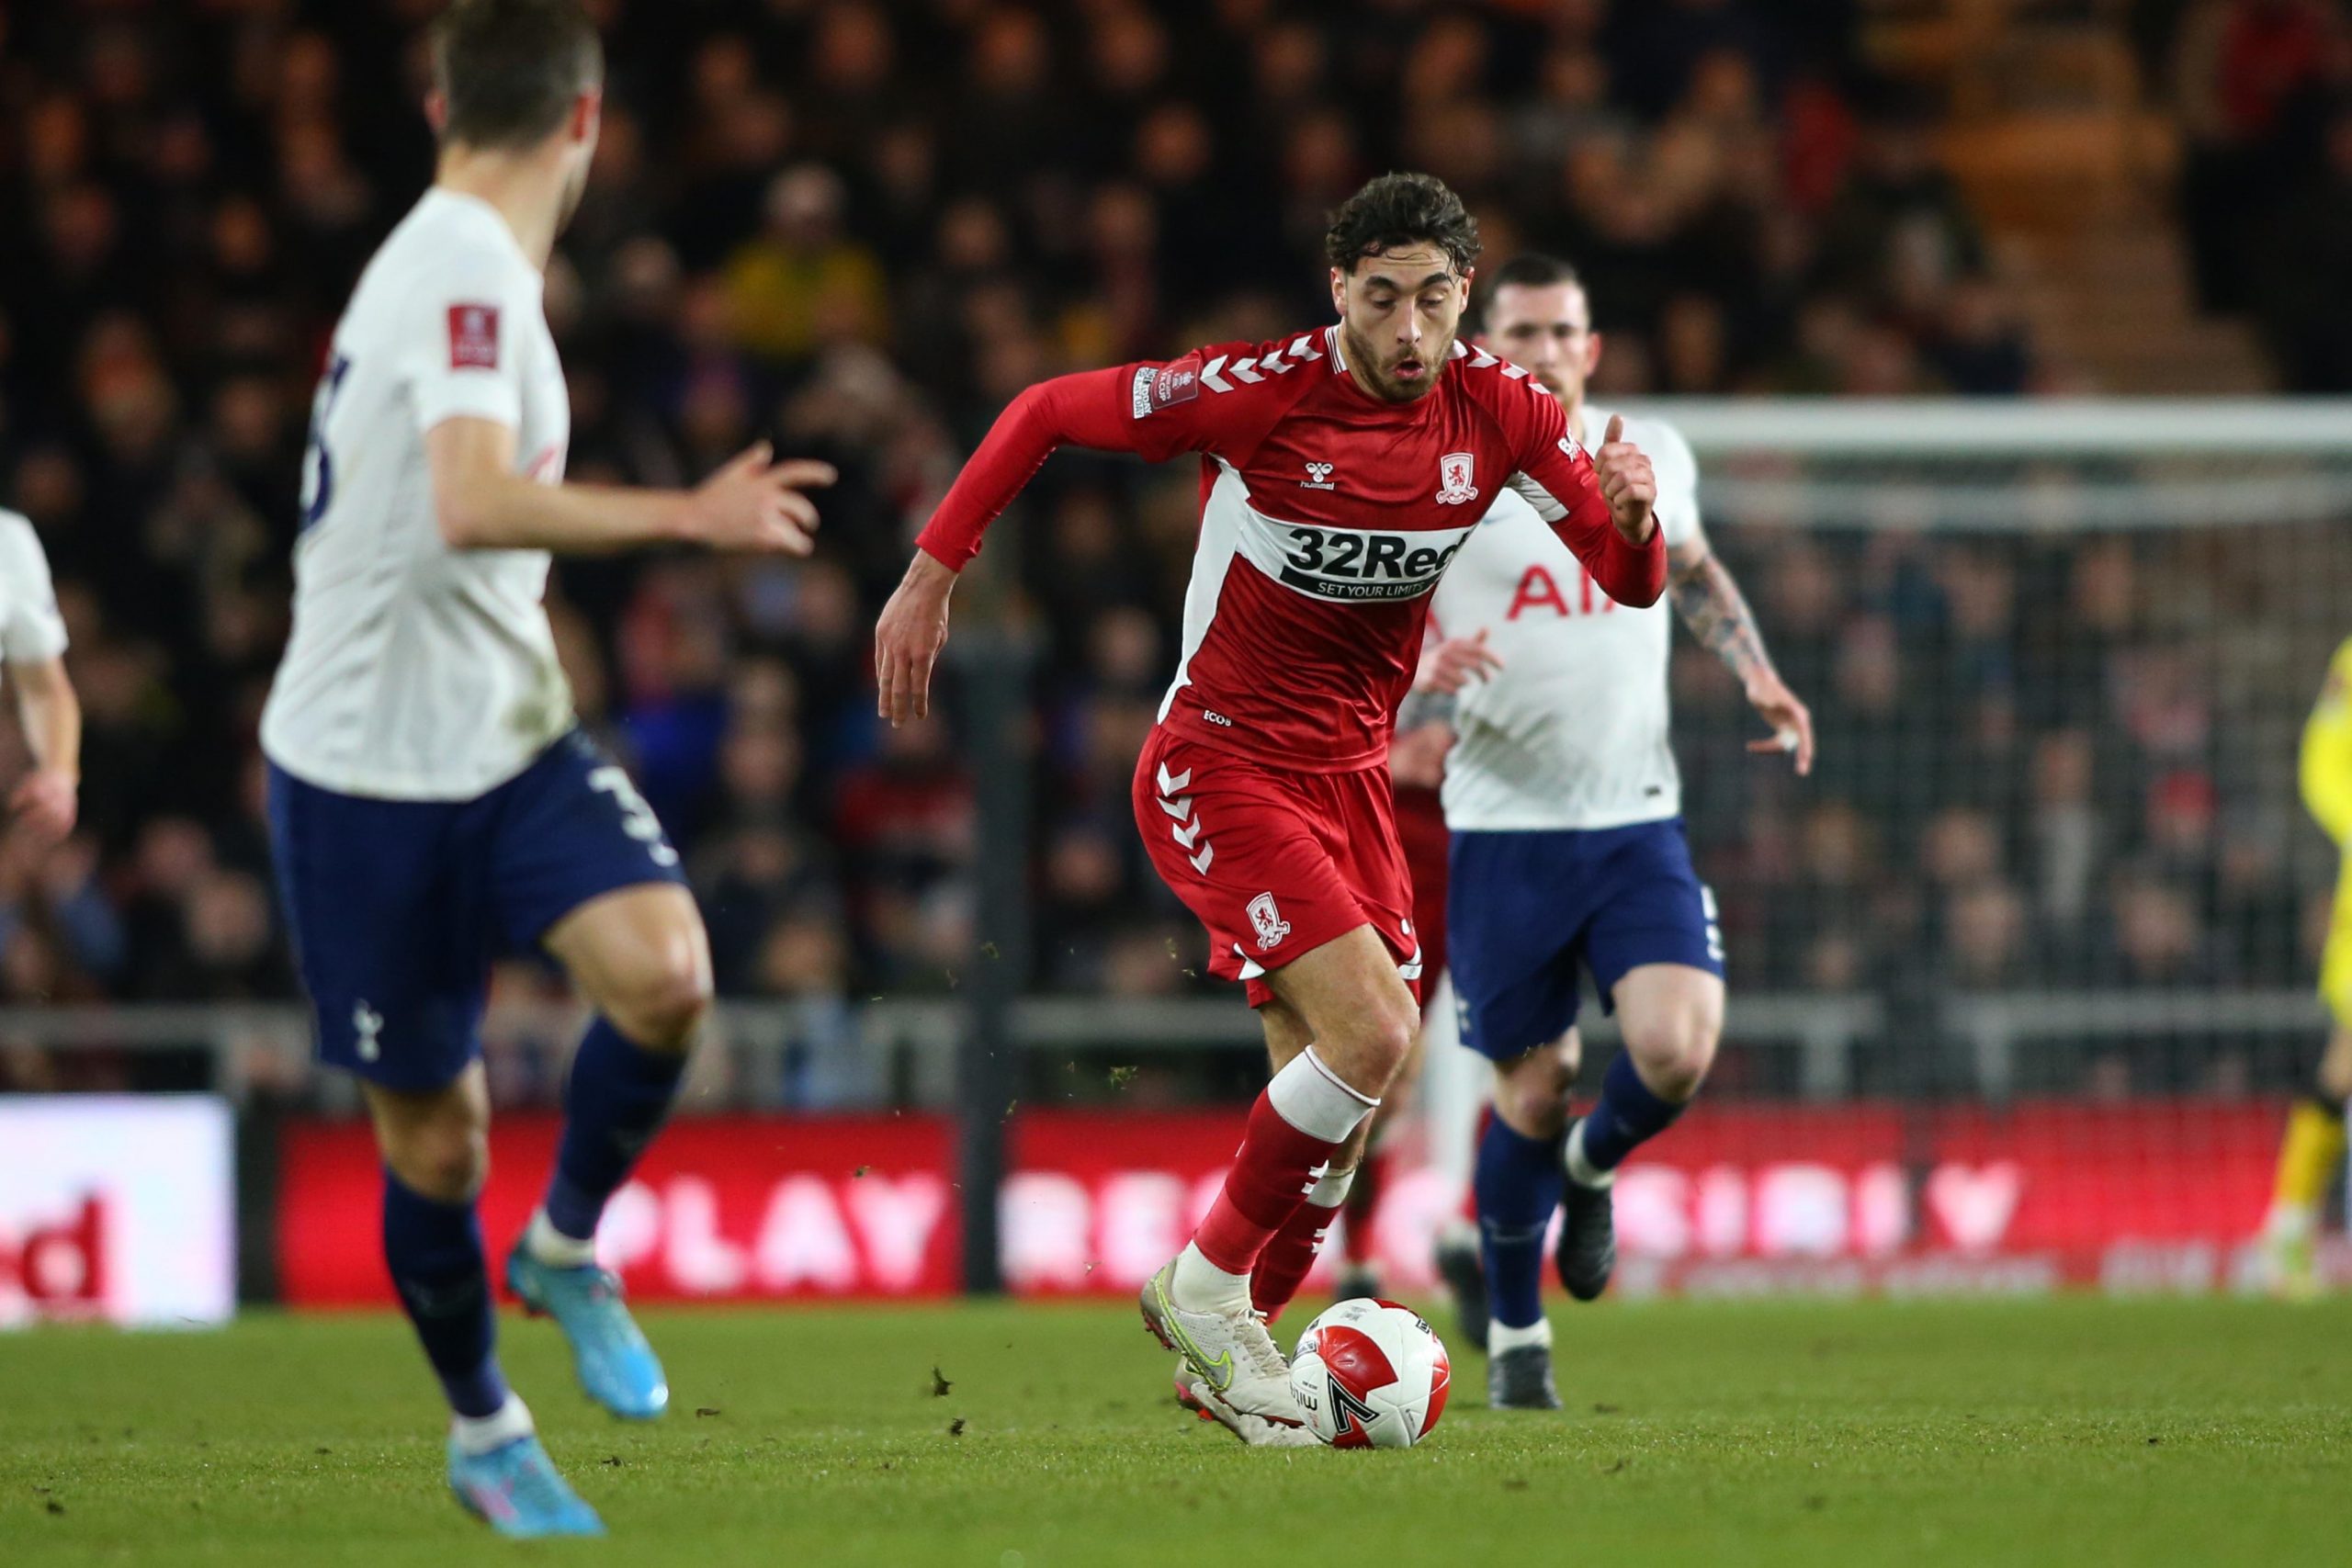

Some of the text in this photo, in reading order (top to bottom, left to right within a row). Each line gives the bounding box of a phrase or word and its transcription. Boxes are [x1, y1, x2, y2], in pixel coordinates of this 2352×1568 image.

[1141, 384, 1152, 414] TODAY
[1159, 382, 1167, 401] CUP
[1300, 480, 1335, 491] hummel
[1317, 581, 1426, 597] SET YOUR LIMITS
[1504, 562, 1615, 622] AI
[1290, 1381, 1317, 1412] mitr
